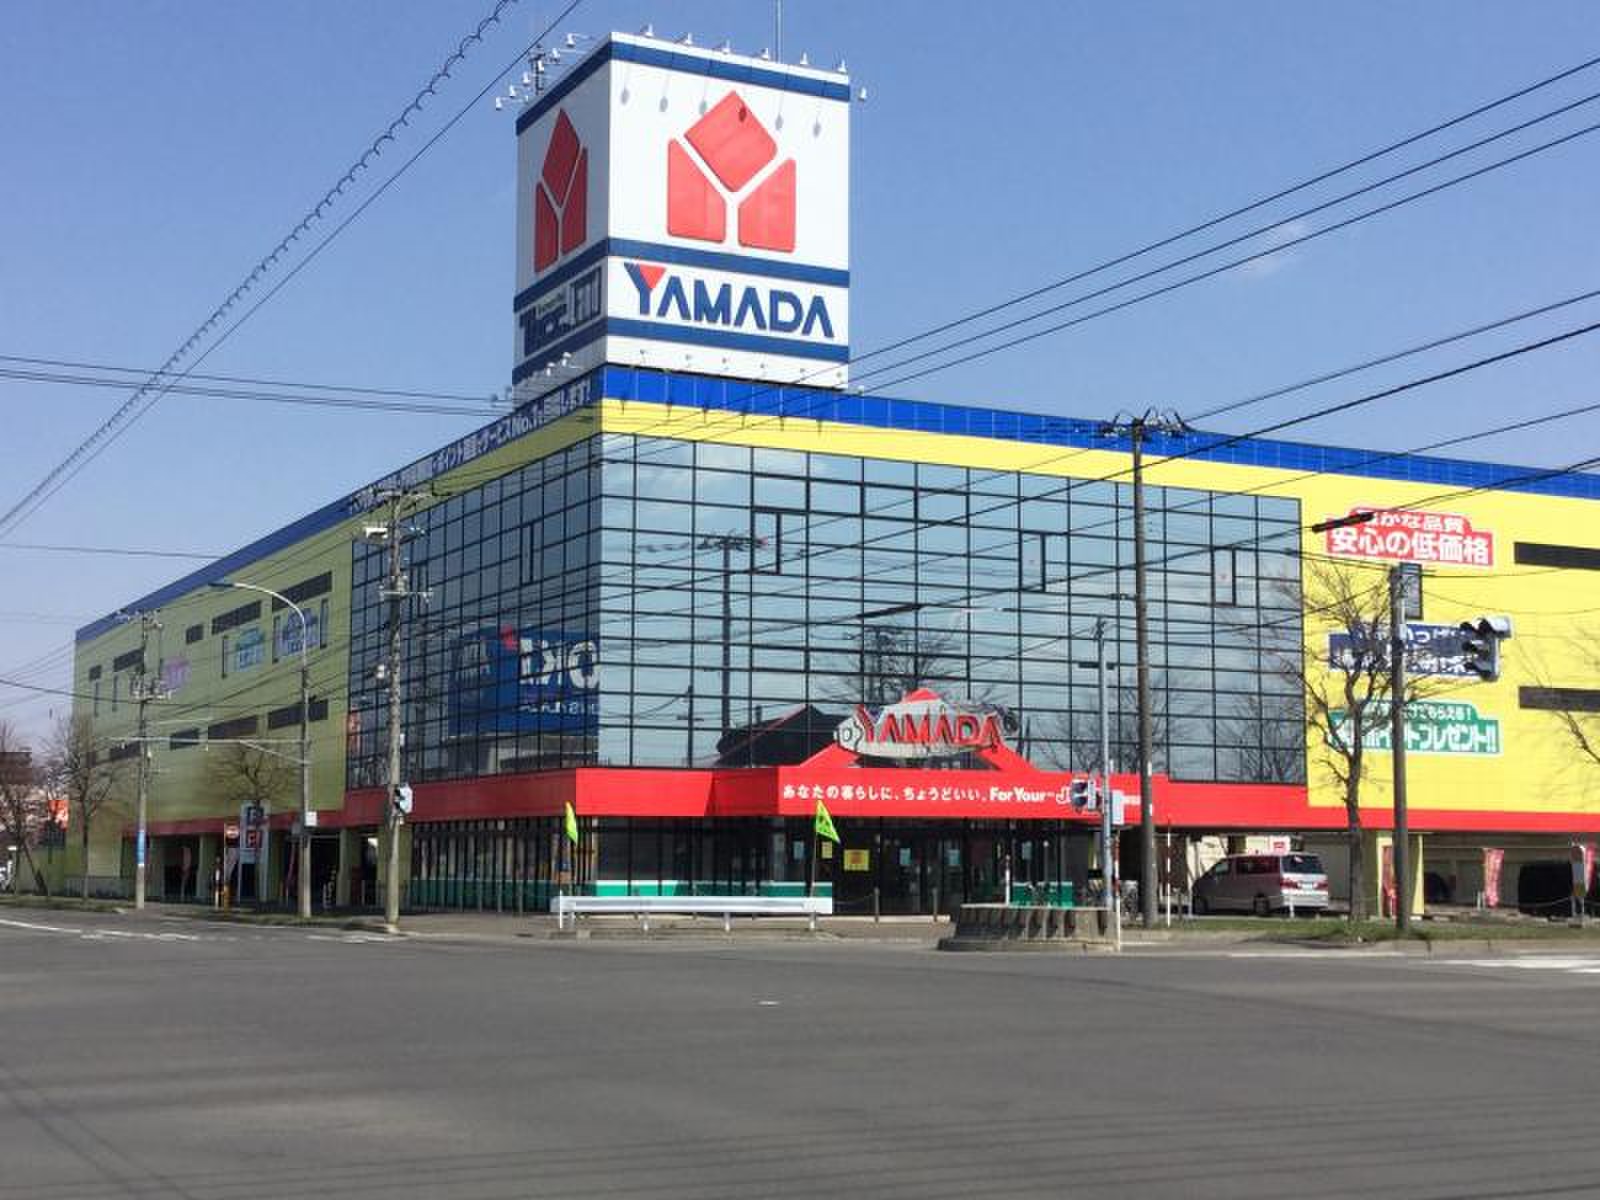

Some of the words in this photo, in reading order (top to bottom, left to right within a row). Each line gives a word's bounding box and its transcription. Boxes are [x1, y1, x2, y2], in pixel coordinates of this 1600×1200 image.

[624, 262, 834, 338] YAMADA
[1331, 526, 1489, 564] 安心の低価格
[855, 703, 1001, 748] YAMADA
[990, 786, 1011, 801] For
[1013, 787, 1046, 802] Your
